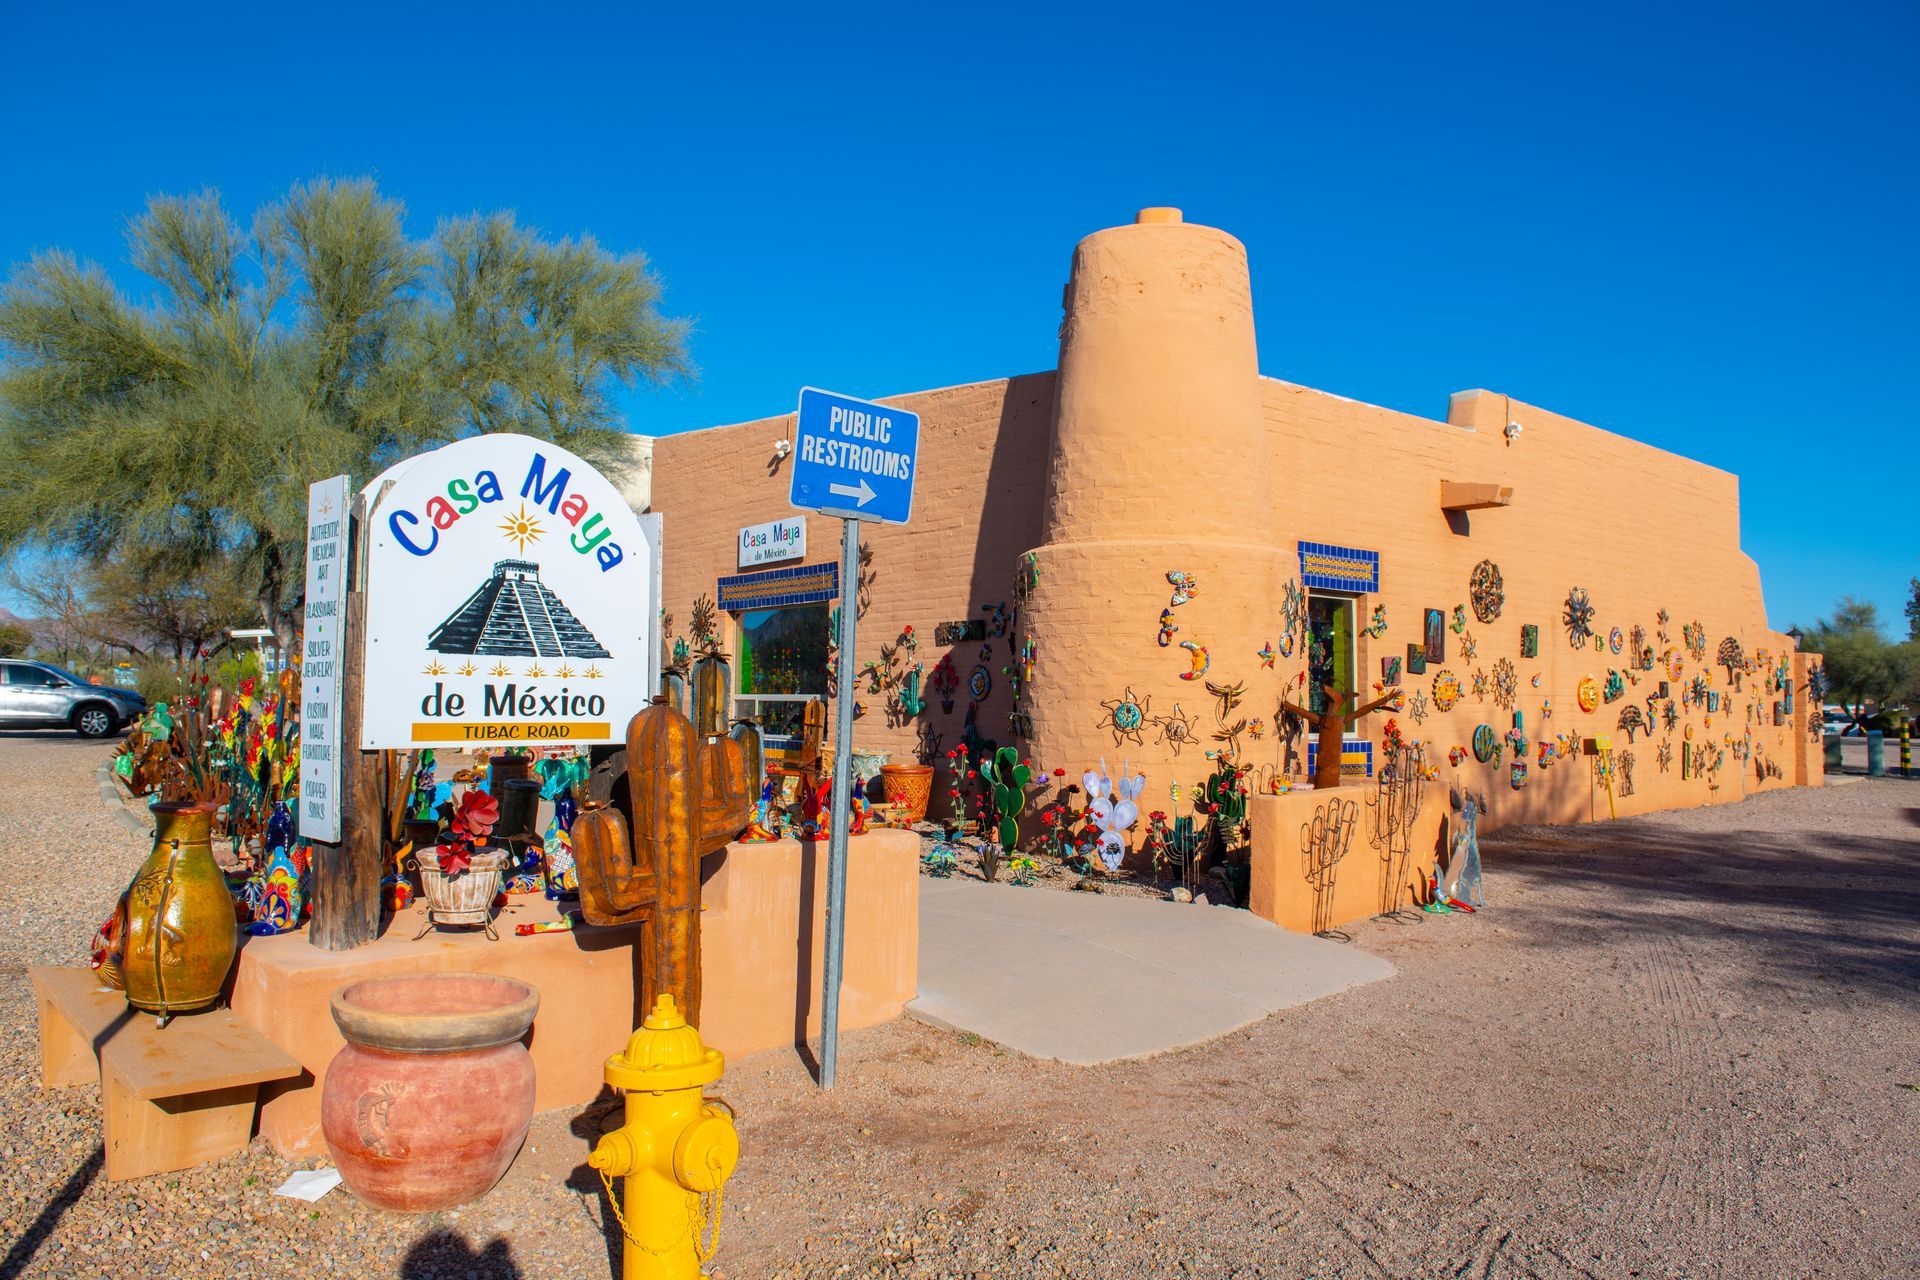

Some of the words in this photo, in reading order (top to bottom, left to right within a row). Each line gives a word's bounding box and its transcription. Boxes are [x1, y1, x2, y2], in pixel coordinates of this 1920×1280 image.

[829, 406, 892, 444] PUBLIC
[801, 434, 911, 480] RESTROOMS
[388, 470, 504, 557] Casa
[519, 452, 624, 573] Maya
[310, 520, 340, 541] AUTHENTIC
[743, 530, 766, 548] Casa
[773, 522, 800, 546] Maya
[311, 542, 336, 561] MEXICAN
[754, 550, 762, 561] de
[764, 548, 787, 559] México
[317, 564, 329, 581] ART
[306, 600, 337, 618] GLASSWARE
[308, 640, 331, 657] SILVER
[303, 661, 334, 677] JEWELRY
[421, 682, 464, 717] de
[484, 684, 605, 717] México
[306, 702, 328, 719] CUSTOM
[310, 723, 324, 739] MADE
[463, 725, 520, 739] TUBAC
[527, 725, 570, 738] ROAD
[303, 744, 331, 761] FURNITURE
[305, 780, 327, 799] COPPER
[308, 801, 325, 820] SINKS
